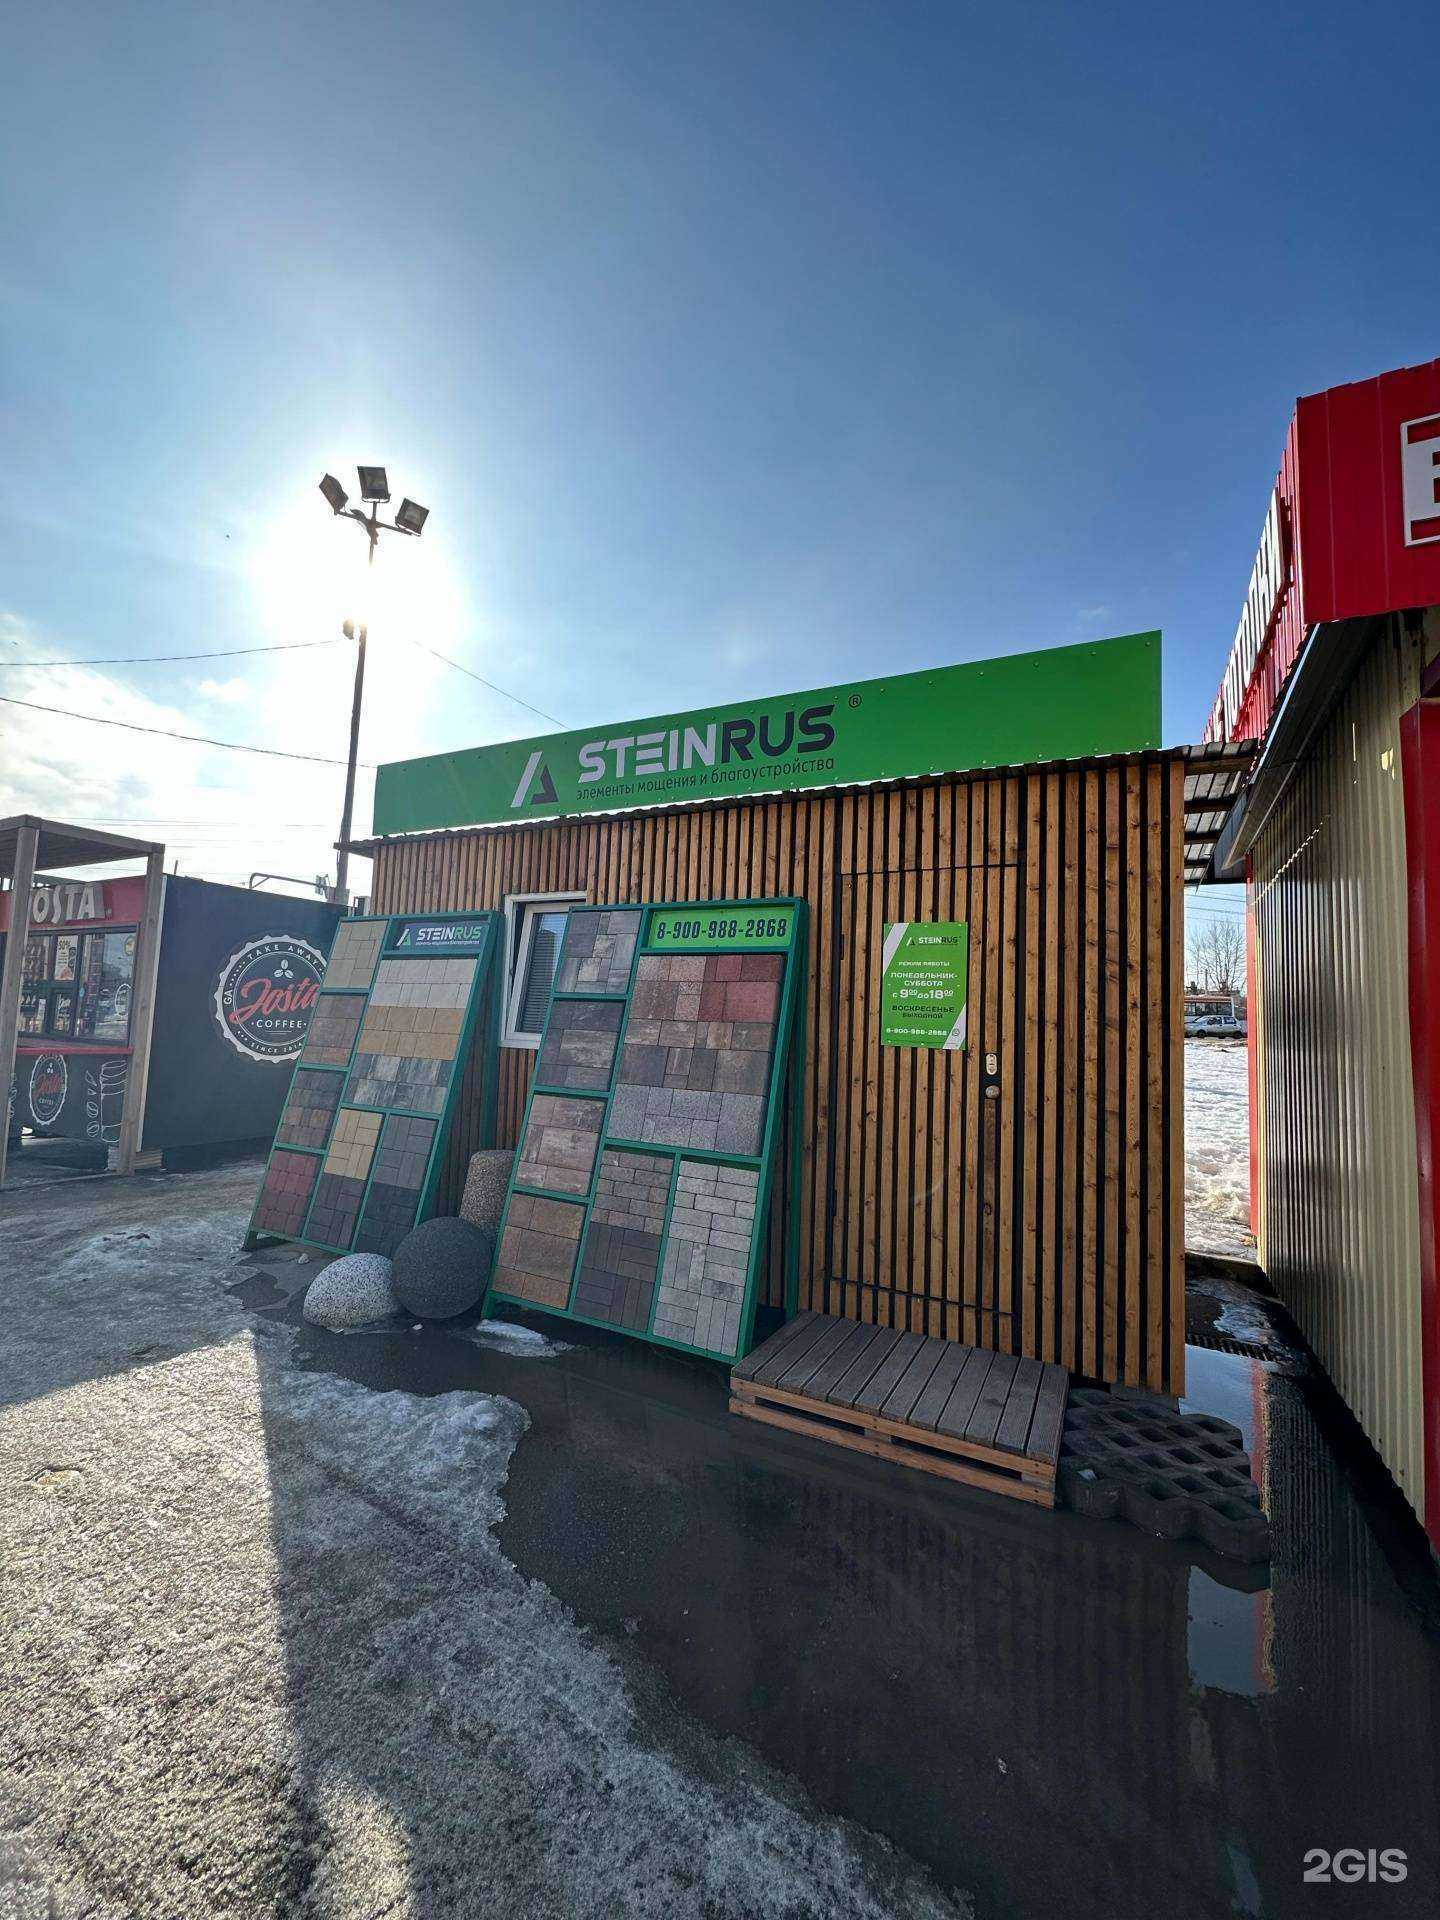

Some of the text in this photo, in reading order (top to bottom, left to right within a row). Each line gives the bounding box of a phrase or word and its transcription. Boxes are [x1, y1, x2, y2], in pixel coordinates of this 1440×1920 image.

[578, 705, 836, 783] STEINRUS
[577, 757, 835, 800] элементы мощения и благоустройства
[32, 884, 96, 923] OSTA
[416, 926, 482, 941] STEINRUS
[657, 918, 787, 940] 8-900-988-2868
[918, 936, 959, 945] STEINRUS
[248, 944, 318, 965] TAKE AWAY
[891, 1004, 956, 1013] ВОСКРЕСЕНЬЕ
[256, 1019, 303, 1029] COFFEE
